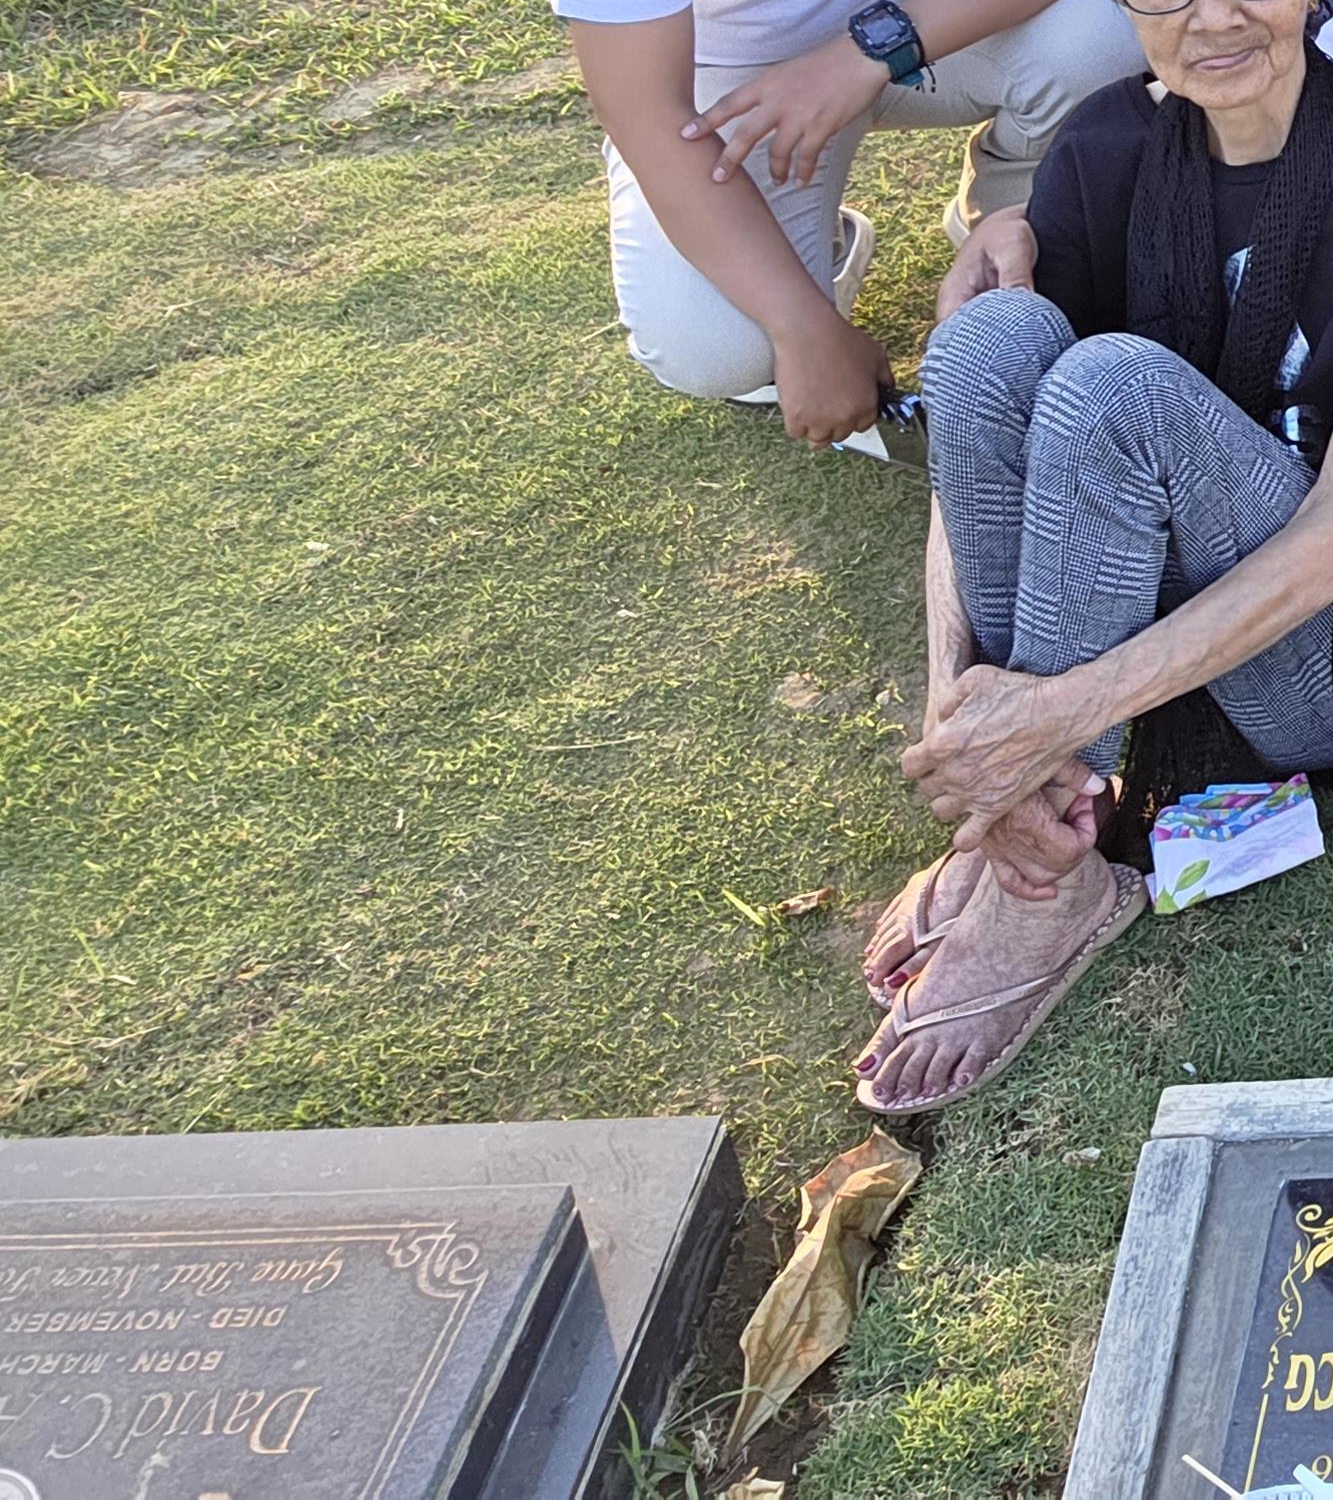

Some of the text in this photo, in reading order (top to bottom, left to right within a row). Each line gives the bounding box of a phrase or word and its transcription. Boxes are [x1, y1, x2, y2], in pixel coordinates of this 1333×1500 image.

[50, 1262, 160, 1301] Never
[159, 1261, 245, 1298] But
[249, 1247, 344, 1295] Gone
[4, 1307, 186, 1334] NOVEMBER
[208, 1304, 289, 1330] DIED
[0, 1351, 110, 1376] MARCH
[128, 1349, 225, 1374] BORN
[44, 1392, 112, 1461] C.
[112, 1385, 323, 1461] David
